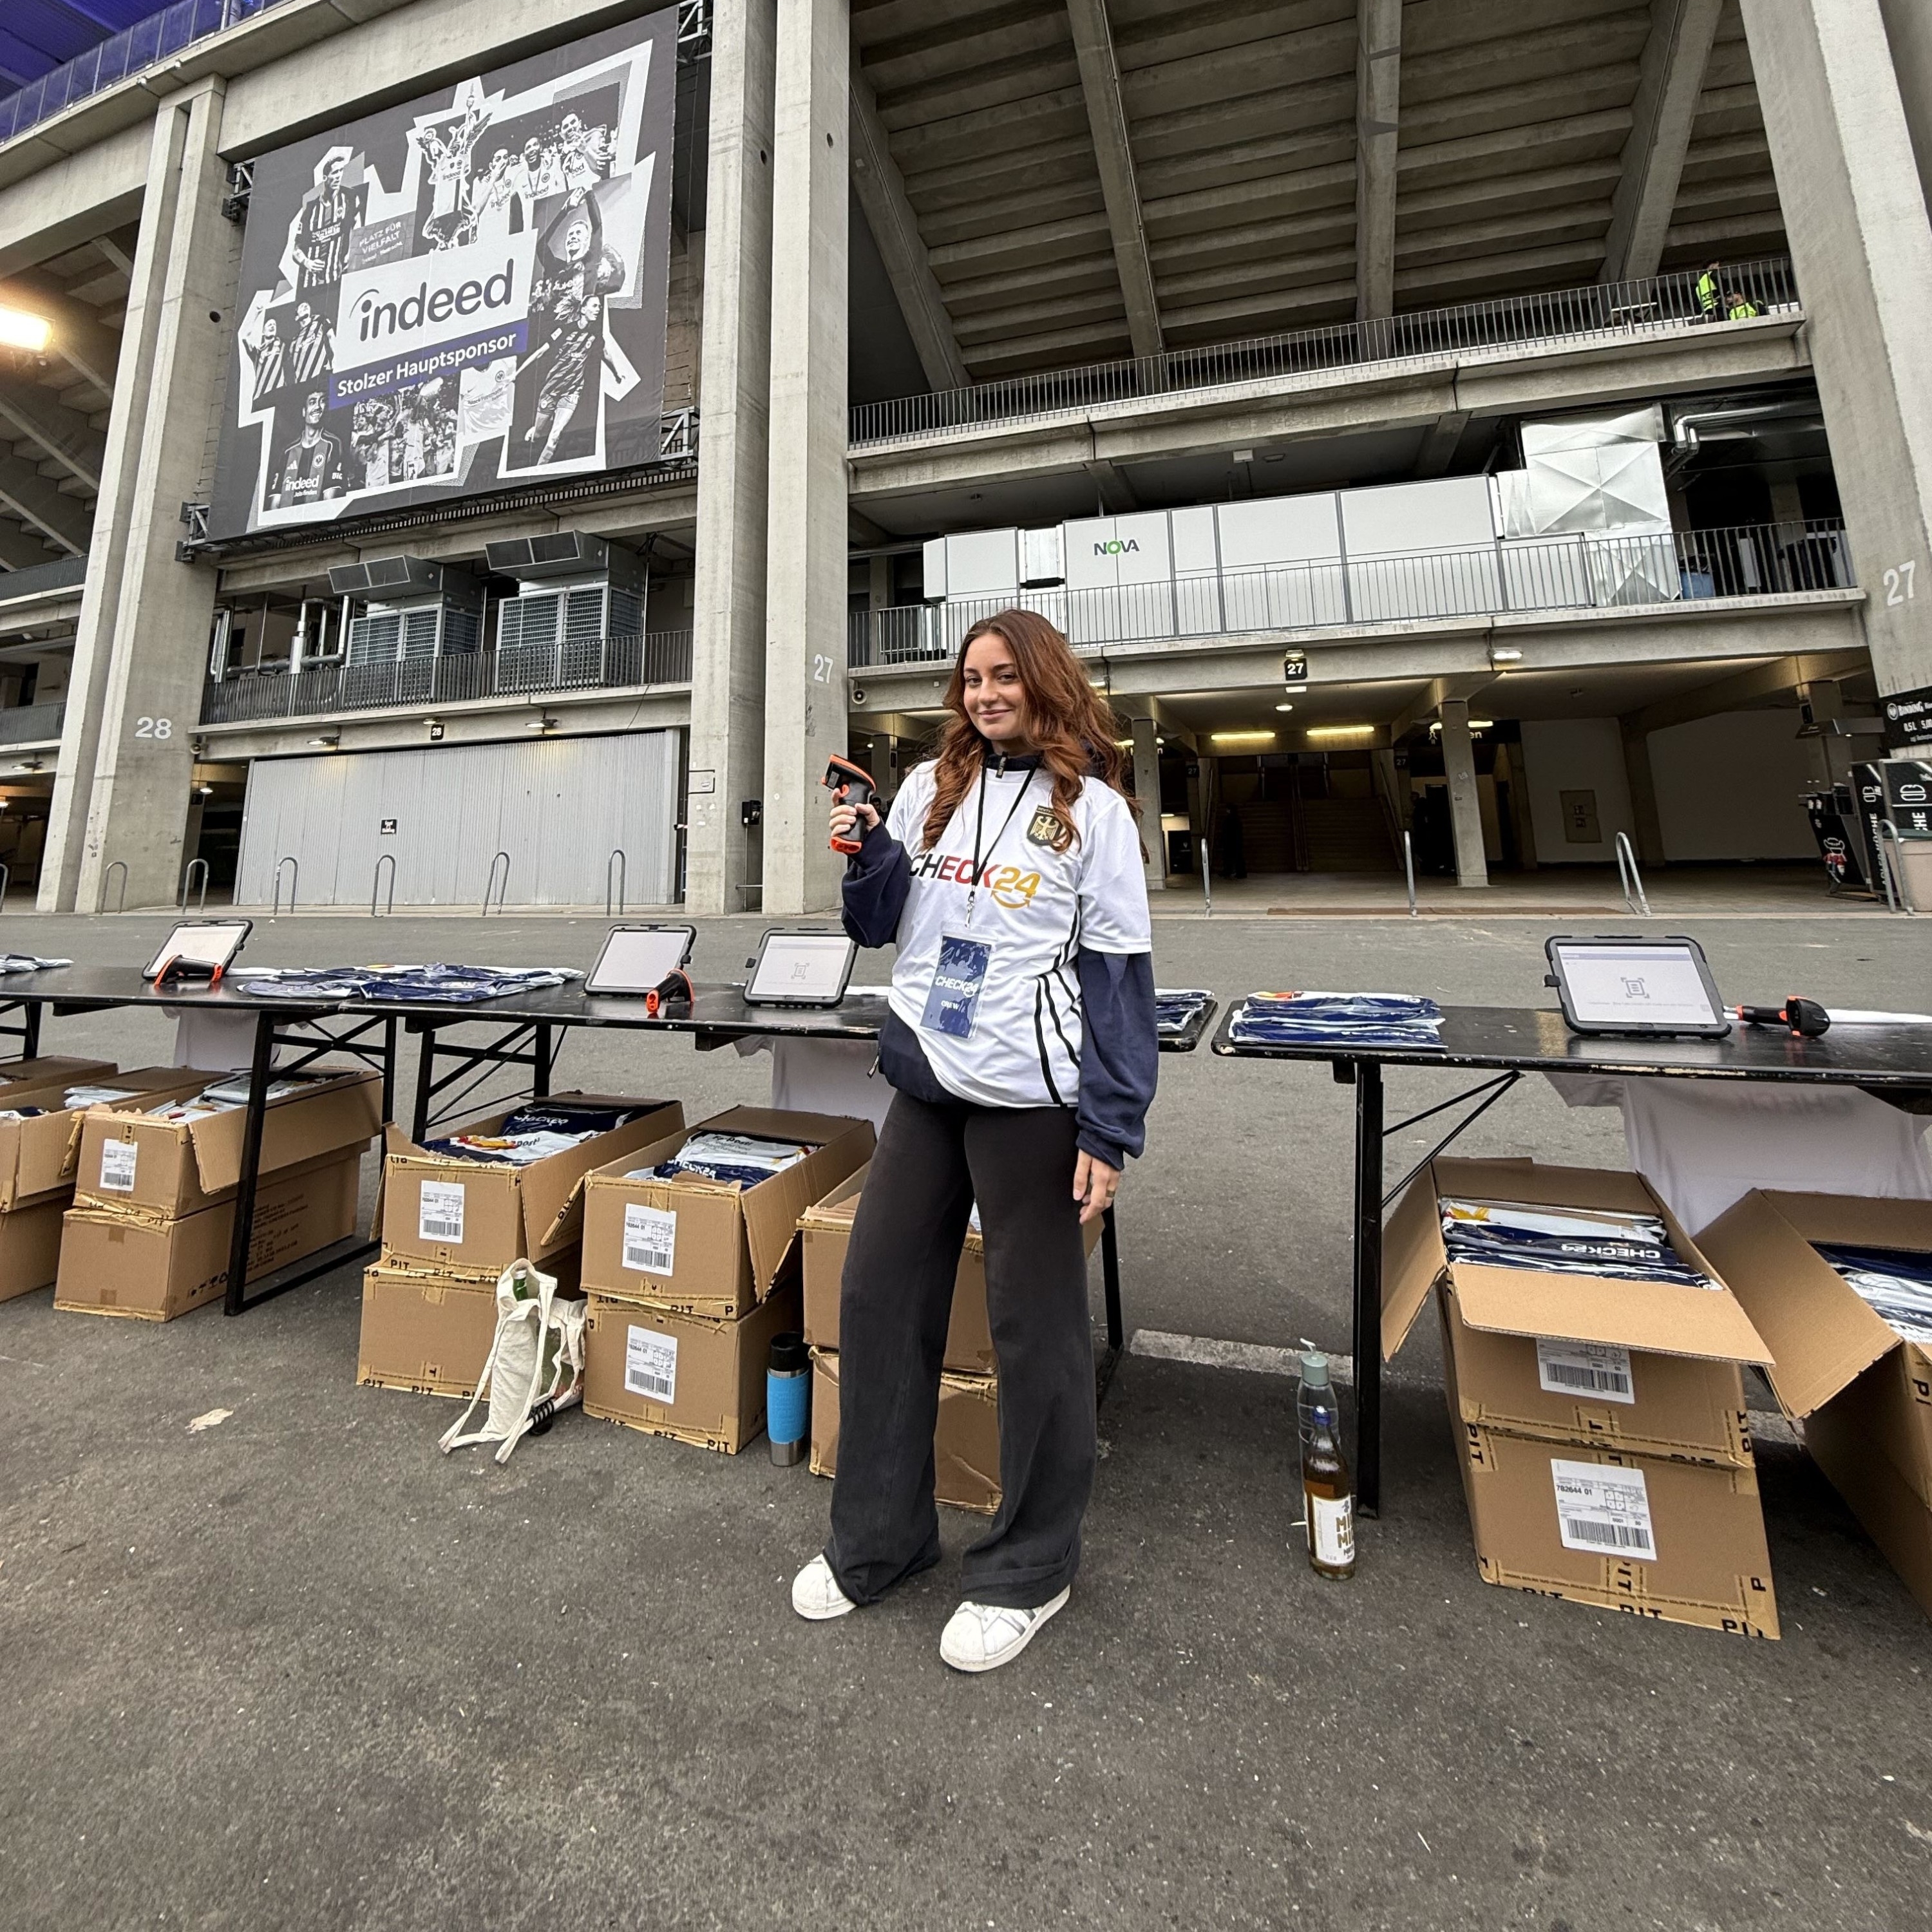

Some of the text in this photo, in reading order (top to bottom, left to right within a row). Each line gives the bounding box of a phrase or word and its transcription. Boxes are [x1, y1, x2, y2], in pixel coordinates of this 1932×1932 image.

[359, 229, 384, 247] PLATZ
[362, 231, 401, 254] VIELFALT
[350, 258, 514, 341] indeed
[337, 332, 517, 397] Stolzer Hauptsponsor
[283, 475, 320, 491] indeed
[1094, 539, 1140, 556] NOVA
[1883, 560, 1915, 606] 27
[815, 654, 833, 684] 27
[1287, 663, 1304, 675] 27
[135, 716, 172, 739] 28
[432, 727, 442, 736] 28
[909, 854, 1041, 900] CHECK24
[935, 976, 980, 996] CHECK24
[941, 1000, 960, 1010] CREW
[1561, 1242, 1661, 1259] CHECK24
[390, 1259, 410, 1271] PIT
[706, 1439, 730, 1453] PIT
[1467, 1423, 1484, 1464] PIT
[1556, 1484, 1582, 1495] 782644
